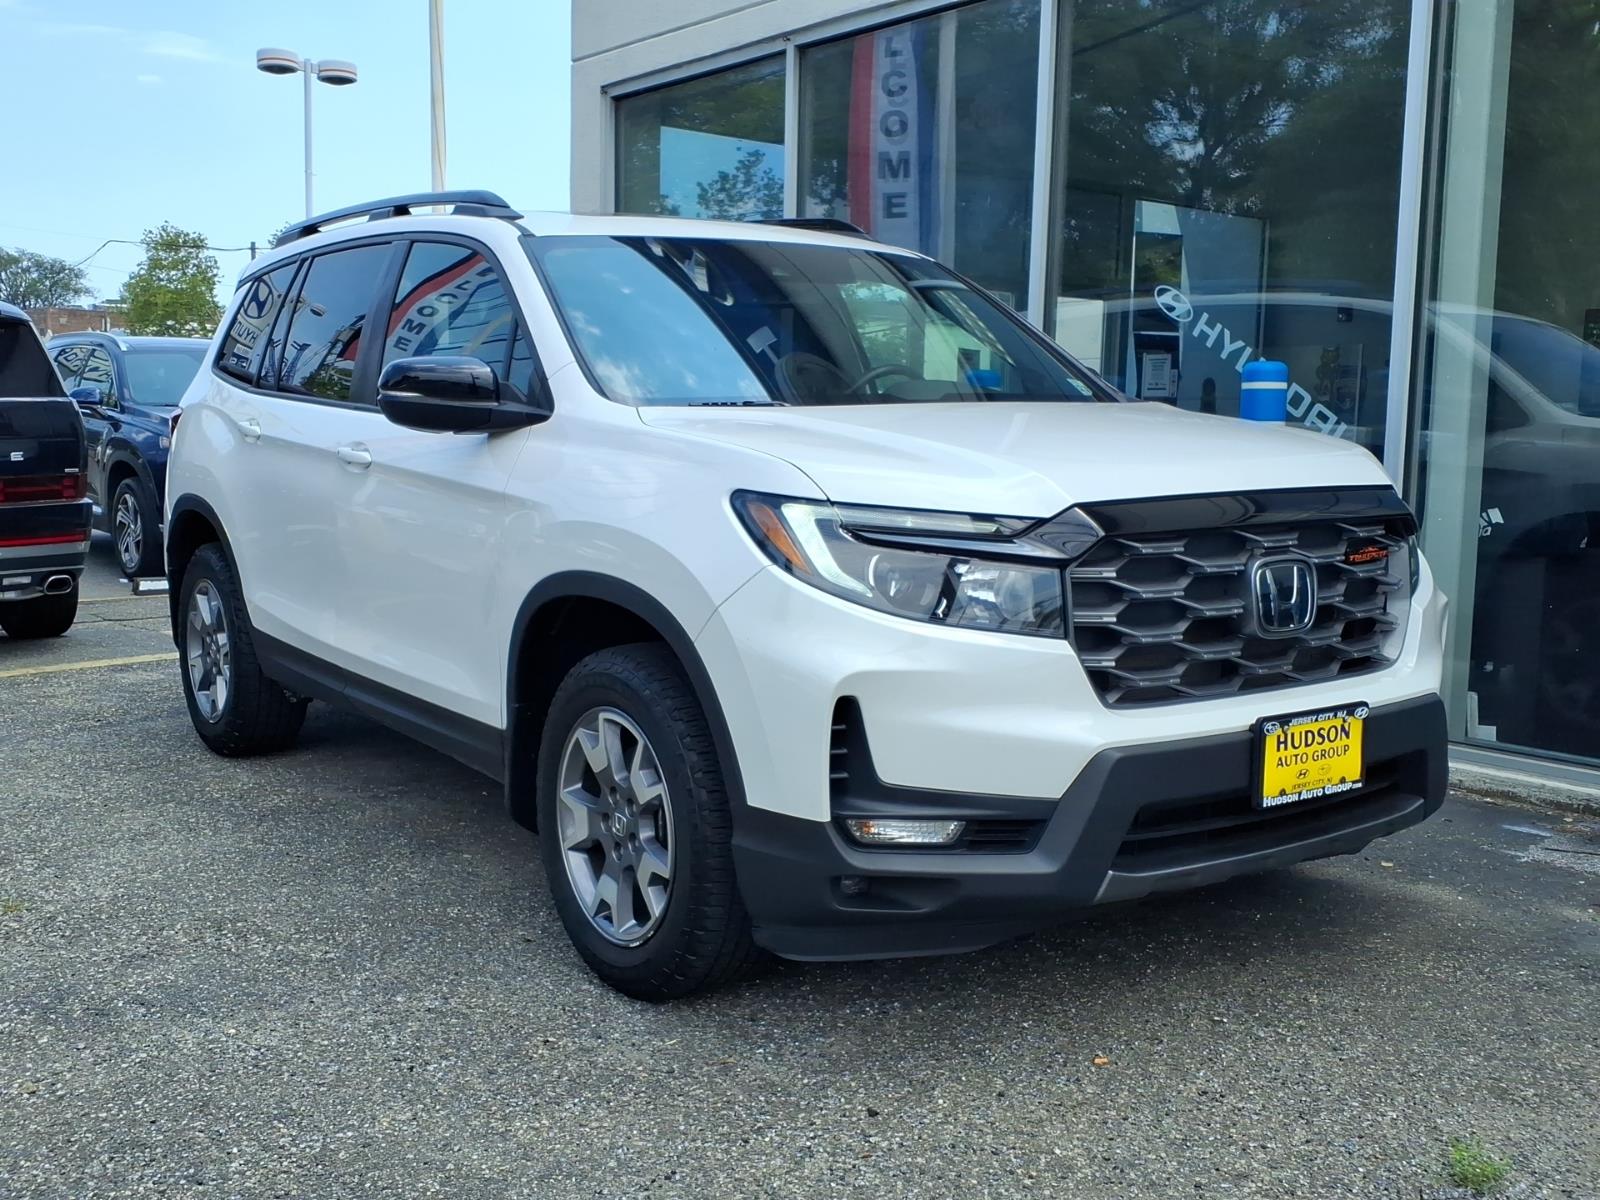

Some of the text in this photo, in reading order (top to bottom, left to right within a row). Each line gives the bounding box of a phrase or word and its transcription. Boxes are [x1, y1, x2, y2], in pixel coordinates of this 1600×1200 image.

[1192, 311, 1348, 439] HYDAI
[1289, 715, 1317, 726] JERSEY
[1276, 722, 1352, 752] HUDSON
[1276, 744, 1350, 768] AUTO GROUP
